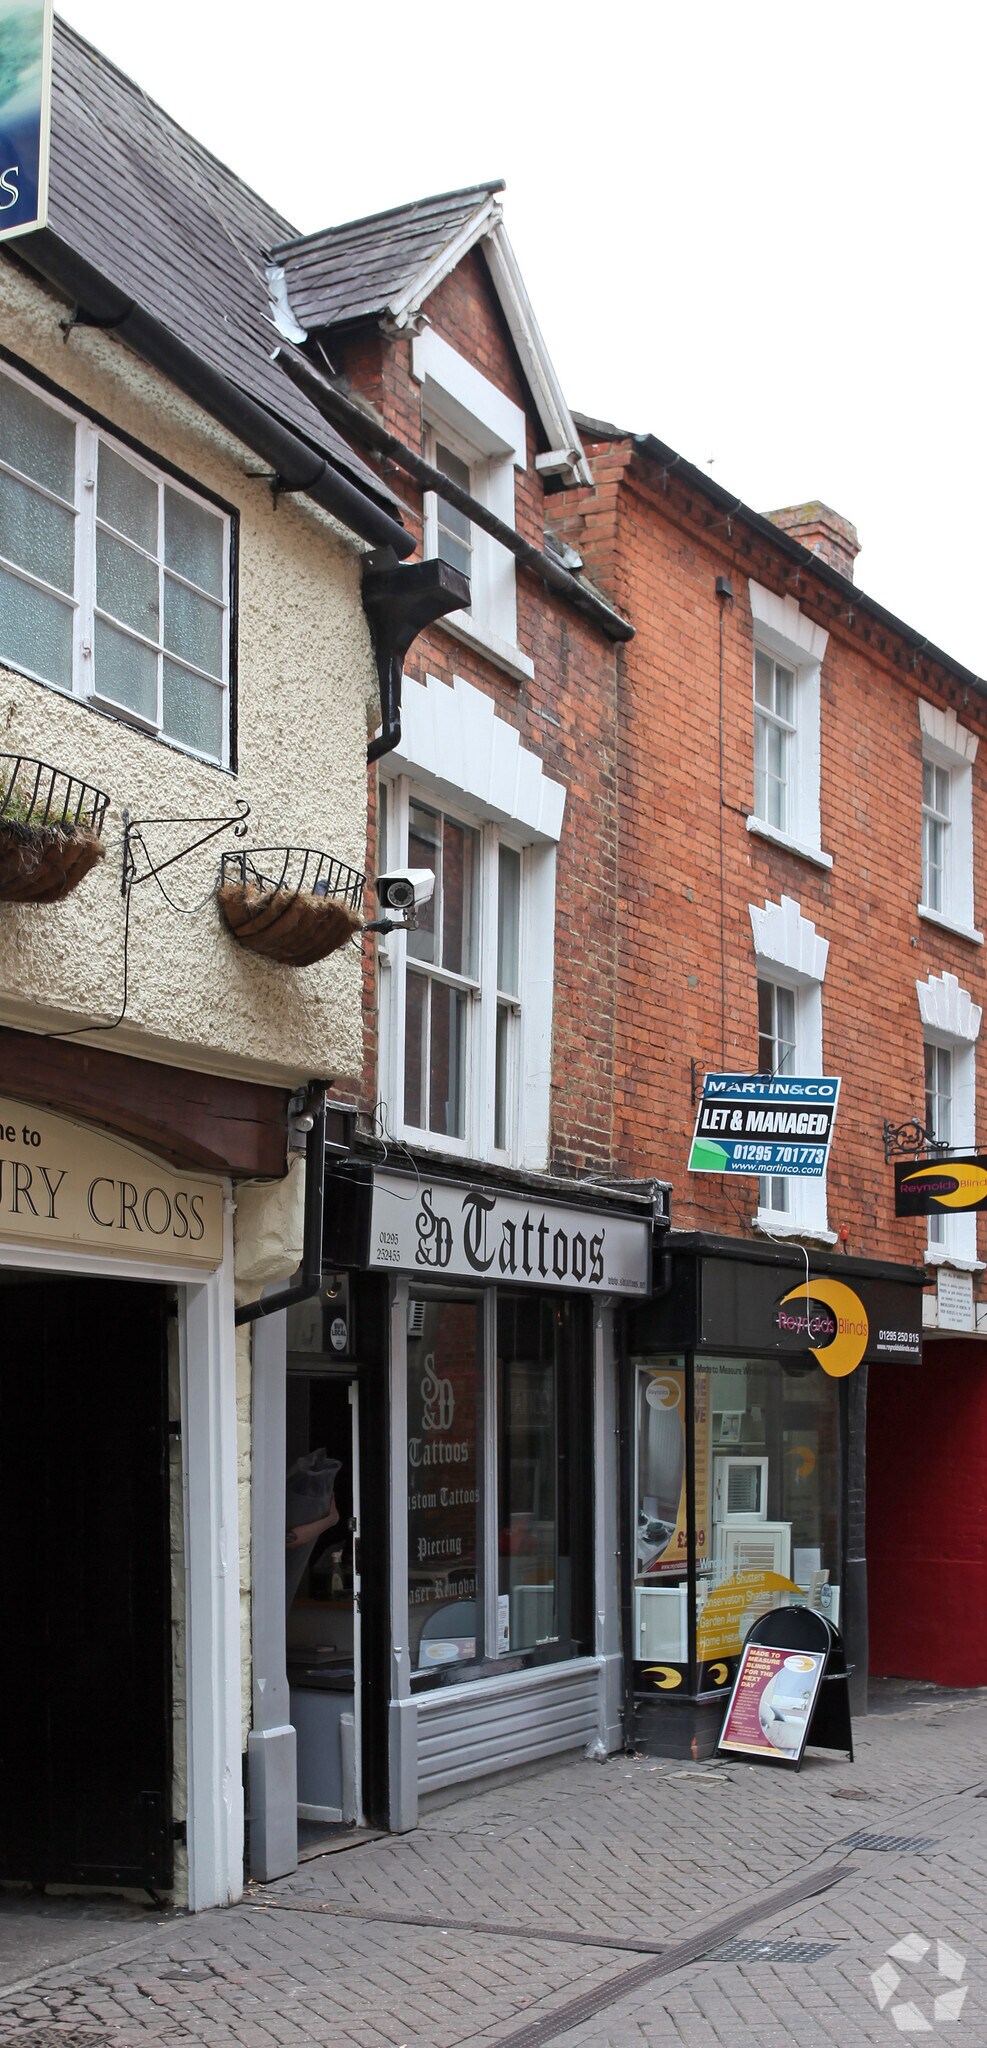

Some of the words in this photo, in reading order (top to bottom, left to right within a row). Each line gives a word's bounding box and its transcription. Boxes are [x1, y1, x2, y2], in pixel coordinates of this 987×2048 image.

[708, 1081, 834, 1096] MARTIN&CO
[701, 1108, 731, 1130] LET
[730, 1109, 743, 1132] &
[745, 1110, 829, 1135] MANAGED
[22, 1125, 42, 1147] to
[733, 1144, 773, 1161] 01295
[775, 1146, 825, 1164] 701773
[731, 1162, 822, 1174] www.martinco.com
[900, 1181, 957, 1194] Reynolds
[87, 1176, 205, 1241] CROSS
[379, 1231, 399, 1245] 01295
[461, 1191, 606, 1285] Tattoos
[376, 1248, 400, 1262] 252455
[334, 1322, 344, 1330] BUY
[777, 1311, 835, 1334] Reynolds
[838, 1317, 868, 1336] Blinds
[332, 1329, 346, 1337] LOCAL
[879, 1330, 897, 1341] 01295
[908, 1333, 920, 1343] 915
[696, 1364, 711, 1374] Made
[712, 1366, 719, 1374] to
[719, 1365, 742, 1375] Measure
[408, 1437, 469, 1468] Tattoos
[440, 1486, 481, 1507] Tattoos
[677, 1529, 706, 1549] £9
[417, 1537, 462, 1562] Piercing
[736, 1571, 765, 1585] Shutters
[409, 1586, 431, 1604] aser
[434, 1574, 479, 1600] Removal
[700, 1615, 725, 1628] Garden
[700, 1635, 720, 1648] Home
[747, 1655, 781, 1666] MEASURE
[749, 1649, 770, 1658] MADE
[744, 1668, 759, 1676] FOR
[760, 1669, 774, 1678] THE
[746, 1662, 771, 1671] BLINDS
[742, 1675, 762, 1683] NEXT
